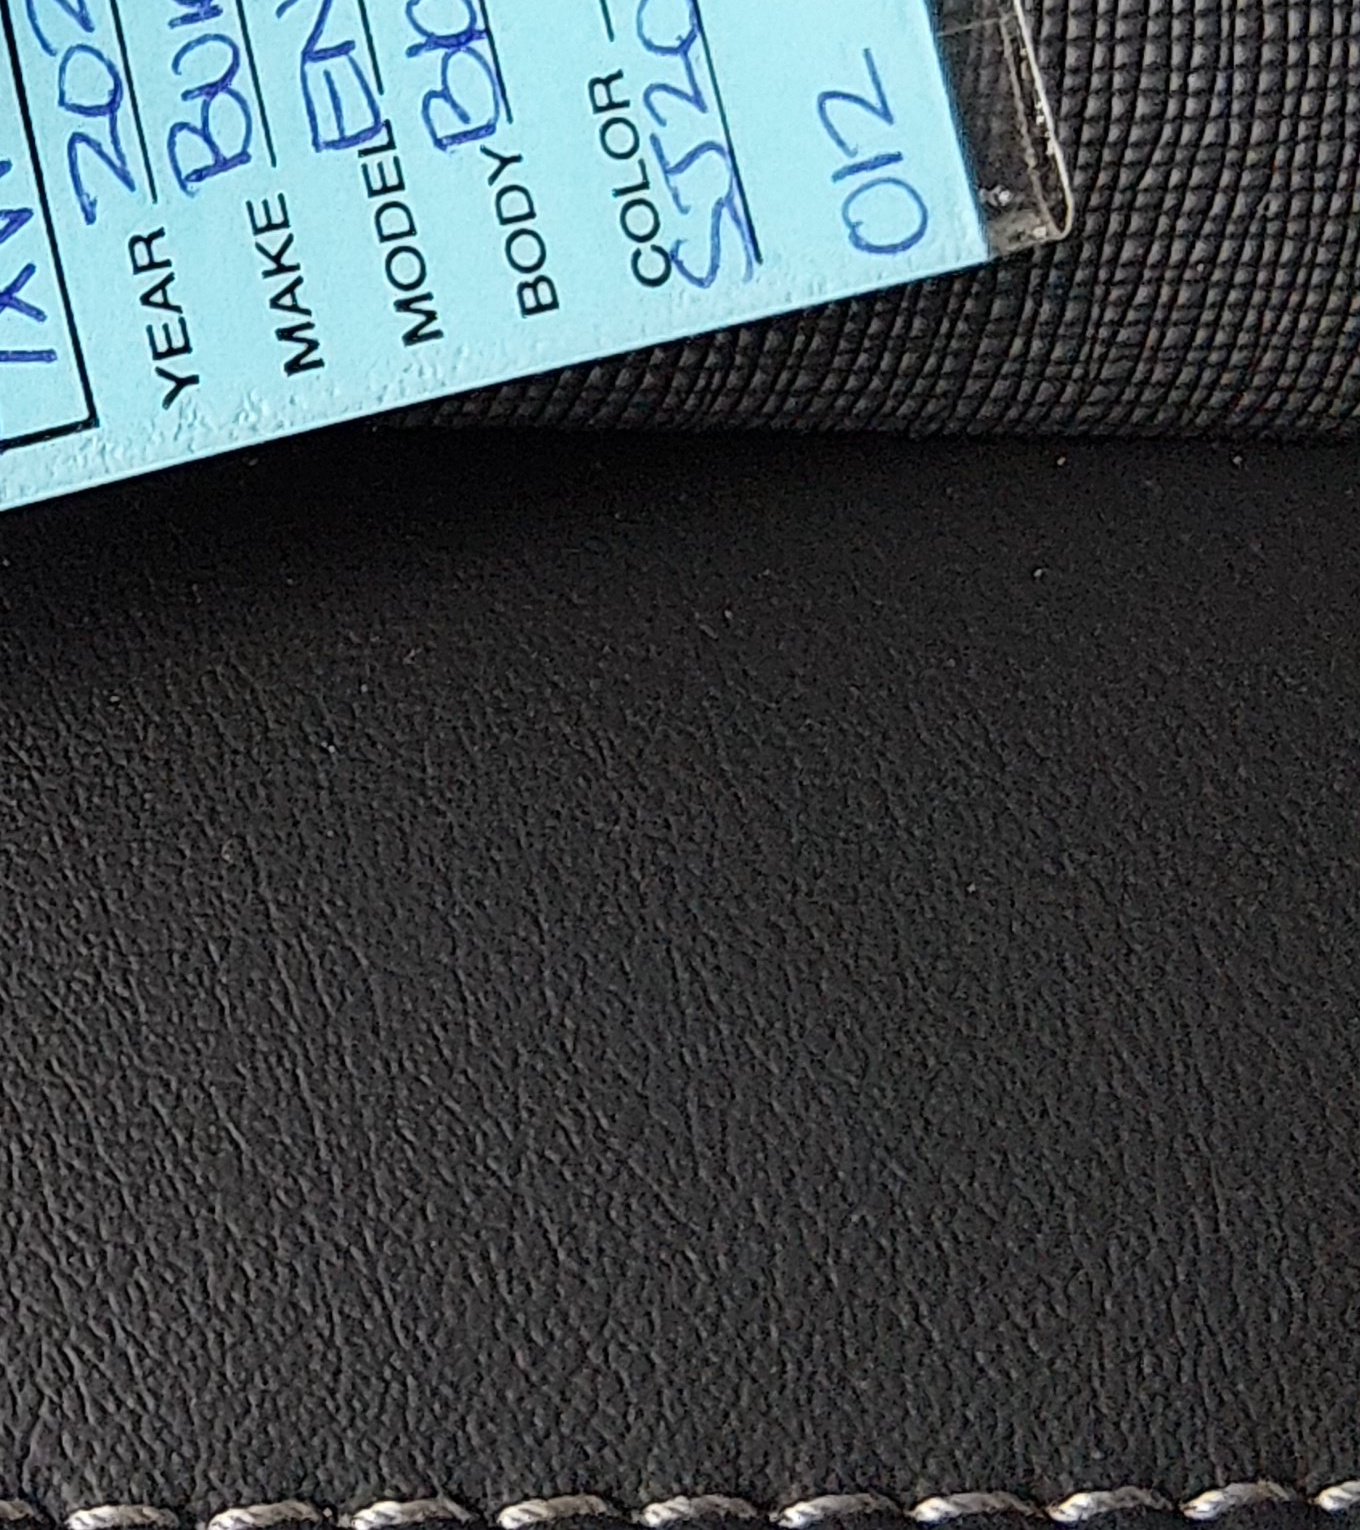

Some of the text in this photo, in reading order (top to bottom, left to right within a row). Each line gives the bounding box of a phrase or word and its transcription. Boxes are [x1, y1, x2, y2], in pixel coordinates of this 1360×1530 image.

[357, 118, 445, 348] MODEL
[479, 144, 560, 319] BODY
[587, 68, 672, 289] COLOR
[816, 46, 929, 256] 012
[128, 226, 200, 410] YEAR
[245, 192, 326, 377] MAKE
